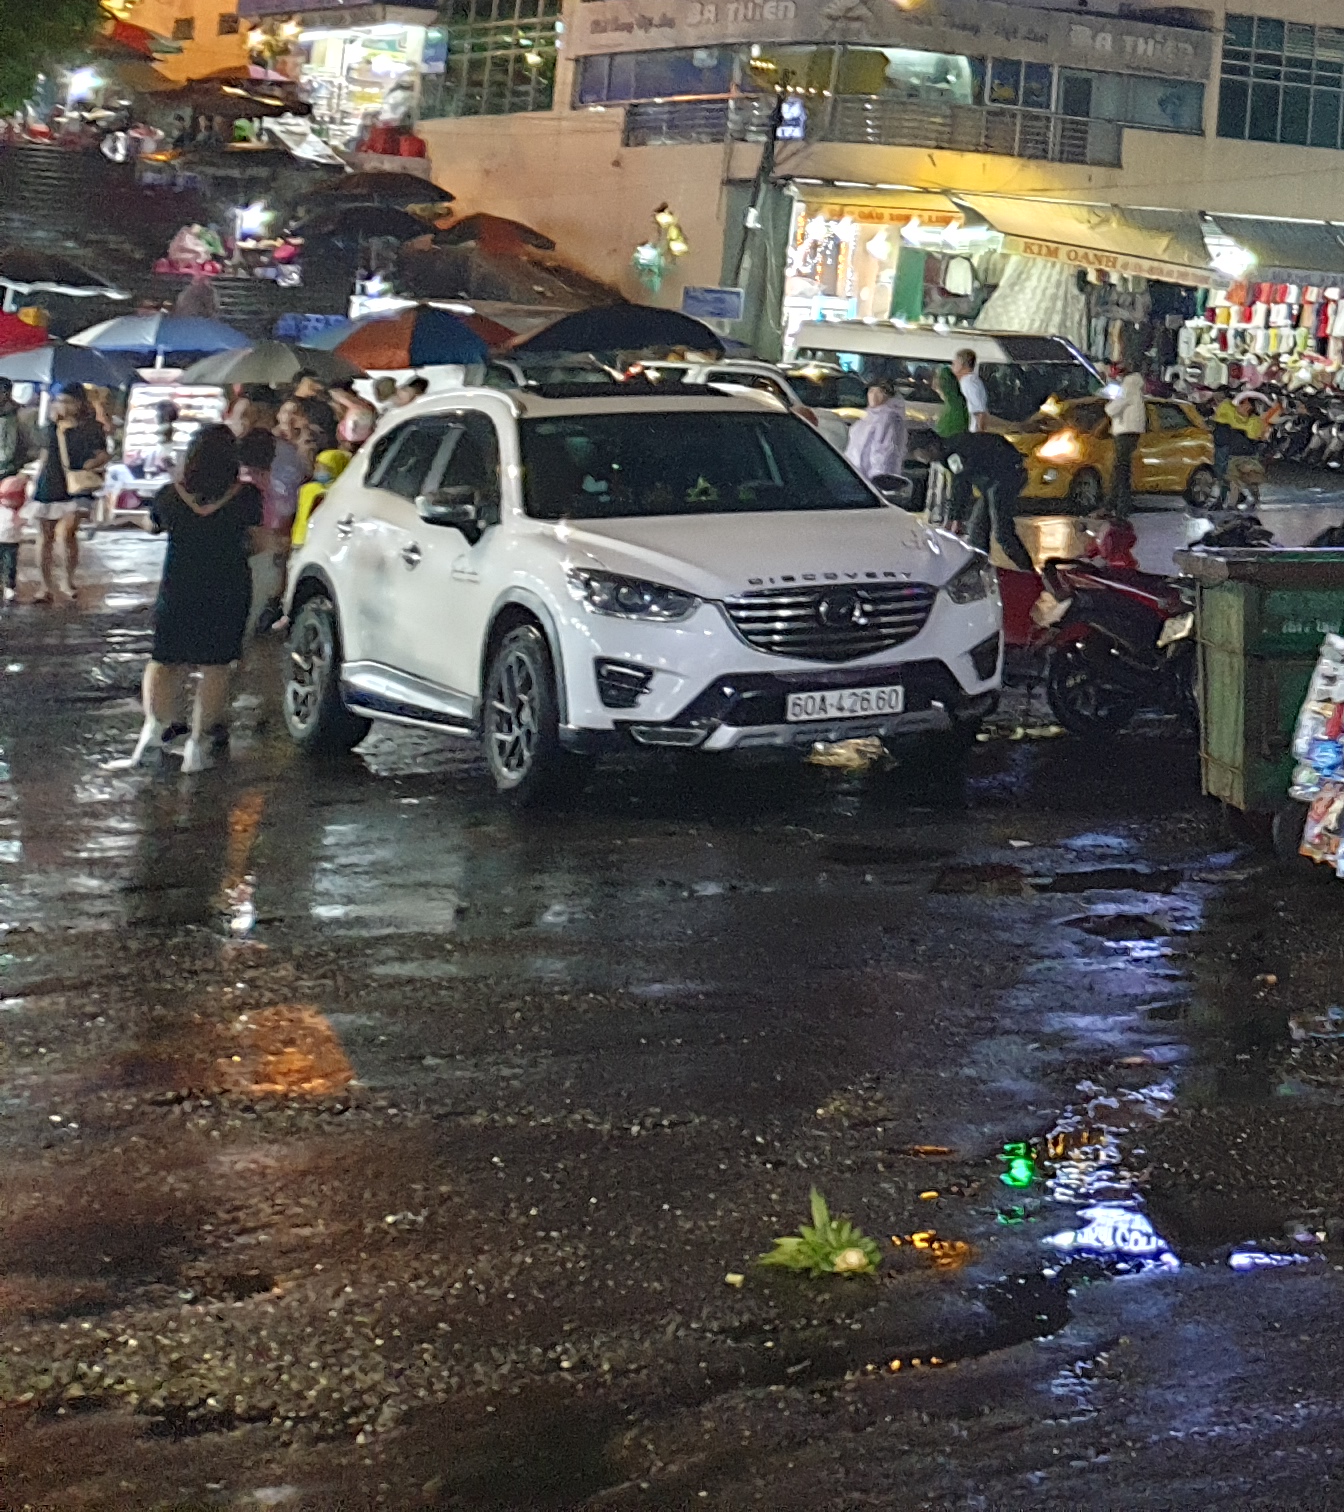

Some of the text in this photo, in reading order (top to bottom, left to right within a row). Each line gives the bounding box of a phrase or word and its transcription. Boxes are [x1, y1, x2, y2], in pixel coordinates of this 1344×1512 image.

[1022, 241, 1119, 269] KIM OANH
[748, 571, 913, 586] DISCOVERY
